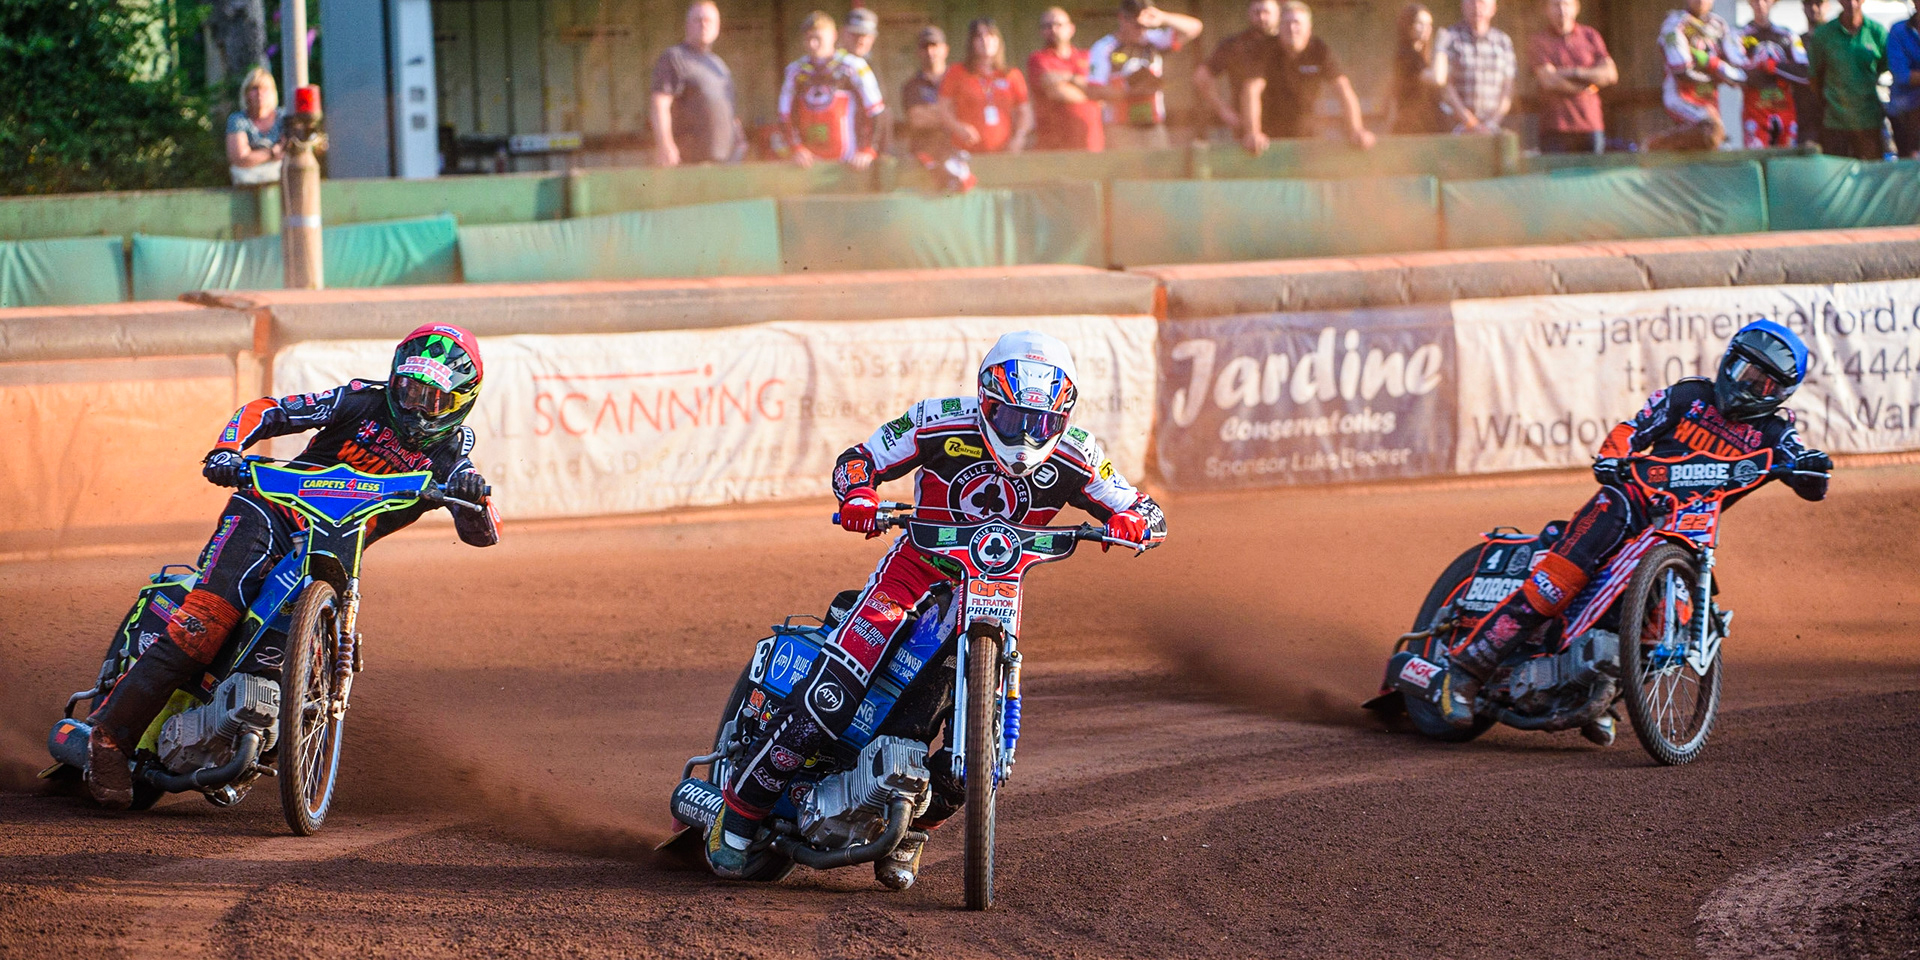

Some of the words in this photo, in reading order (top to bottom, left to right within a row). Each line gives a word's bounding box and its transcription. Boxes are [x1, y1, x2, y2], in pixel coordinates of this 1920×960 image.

[1171, 326, 1443, 428] Jardine
[533, 370, 786, 437] SCANNING
[1219, 405, 1397, 443] Conservatories
[1670, 463, 1730, 481] BORGE
[303, 480, 345, 489] CARPETS
[346, 478, 357, 491] 4
[356, 483, 380, 491] LESS
[957, 465, 987, 486] BELLE
[1012, 479, 1027, 503] ACES
[1678, 513, 1711, 531] 22
[973, 529, 989, 544] BELLE
[1486, 549, 1503, 570] 4
[969, 579, 1018, 599] CFS
[966, 606, 1017, 618] PREMIER
[971, 599, 1013, 608] FILTRATION
[851, 624, 879, 647] PROJECT
[854, 616, 872, 633] BLUE
[869, 627, 886, 645] DOOR
[755, 643, 771, 678] 3
[1404, 659, 1438, 680] NGK
[820, 687, 840, 708] ATPI
[677, 783, 724, 811] PREMI
[678, 802, 698, 819] 01912
